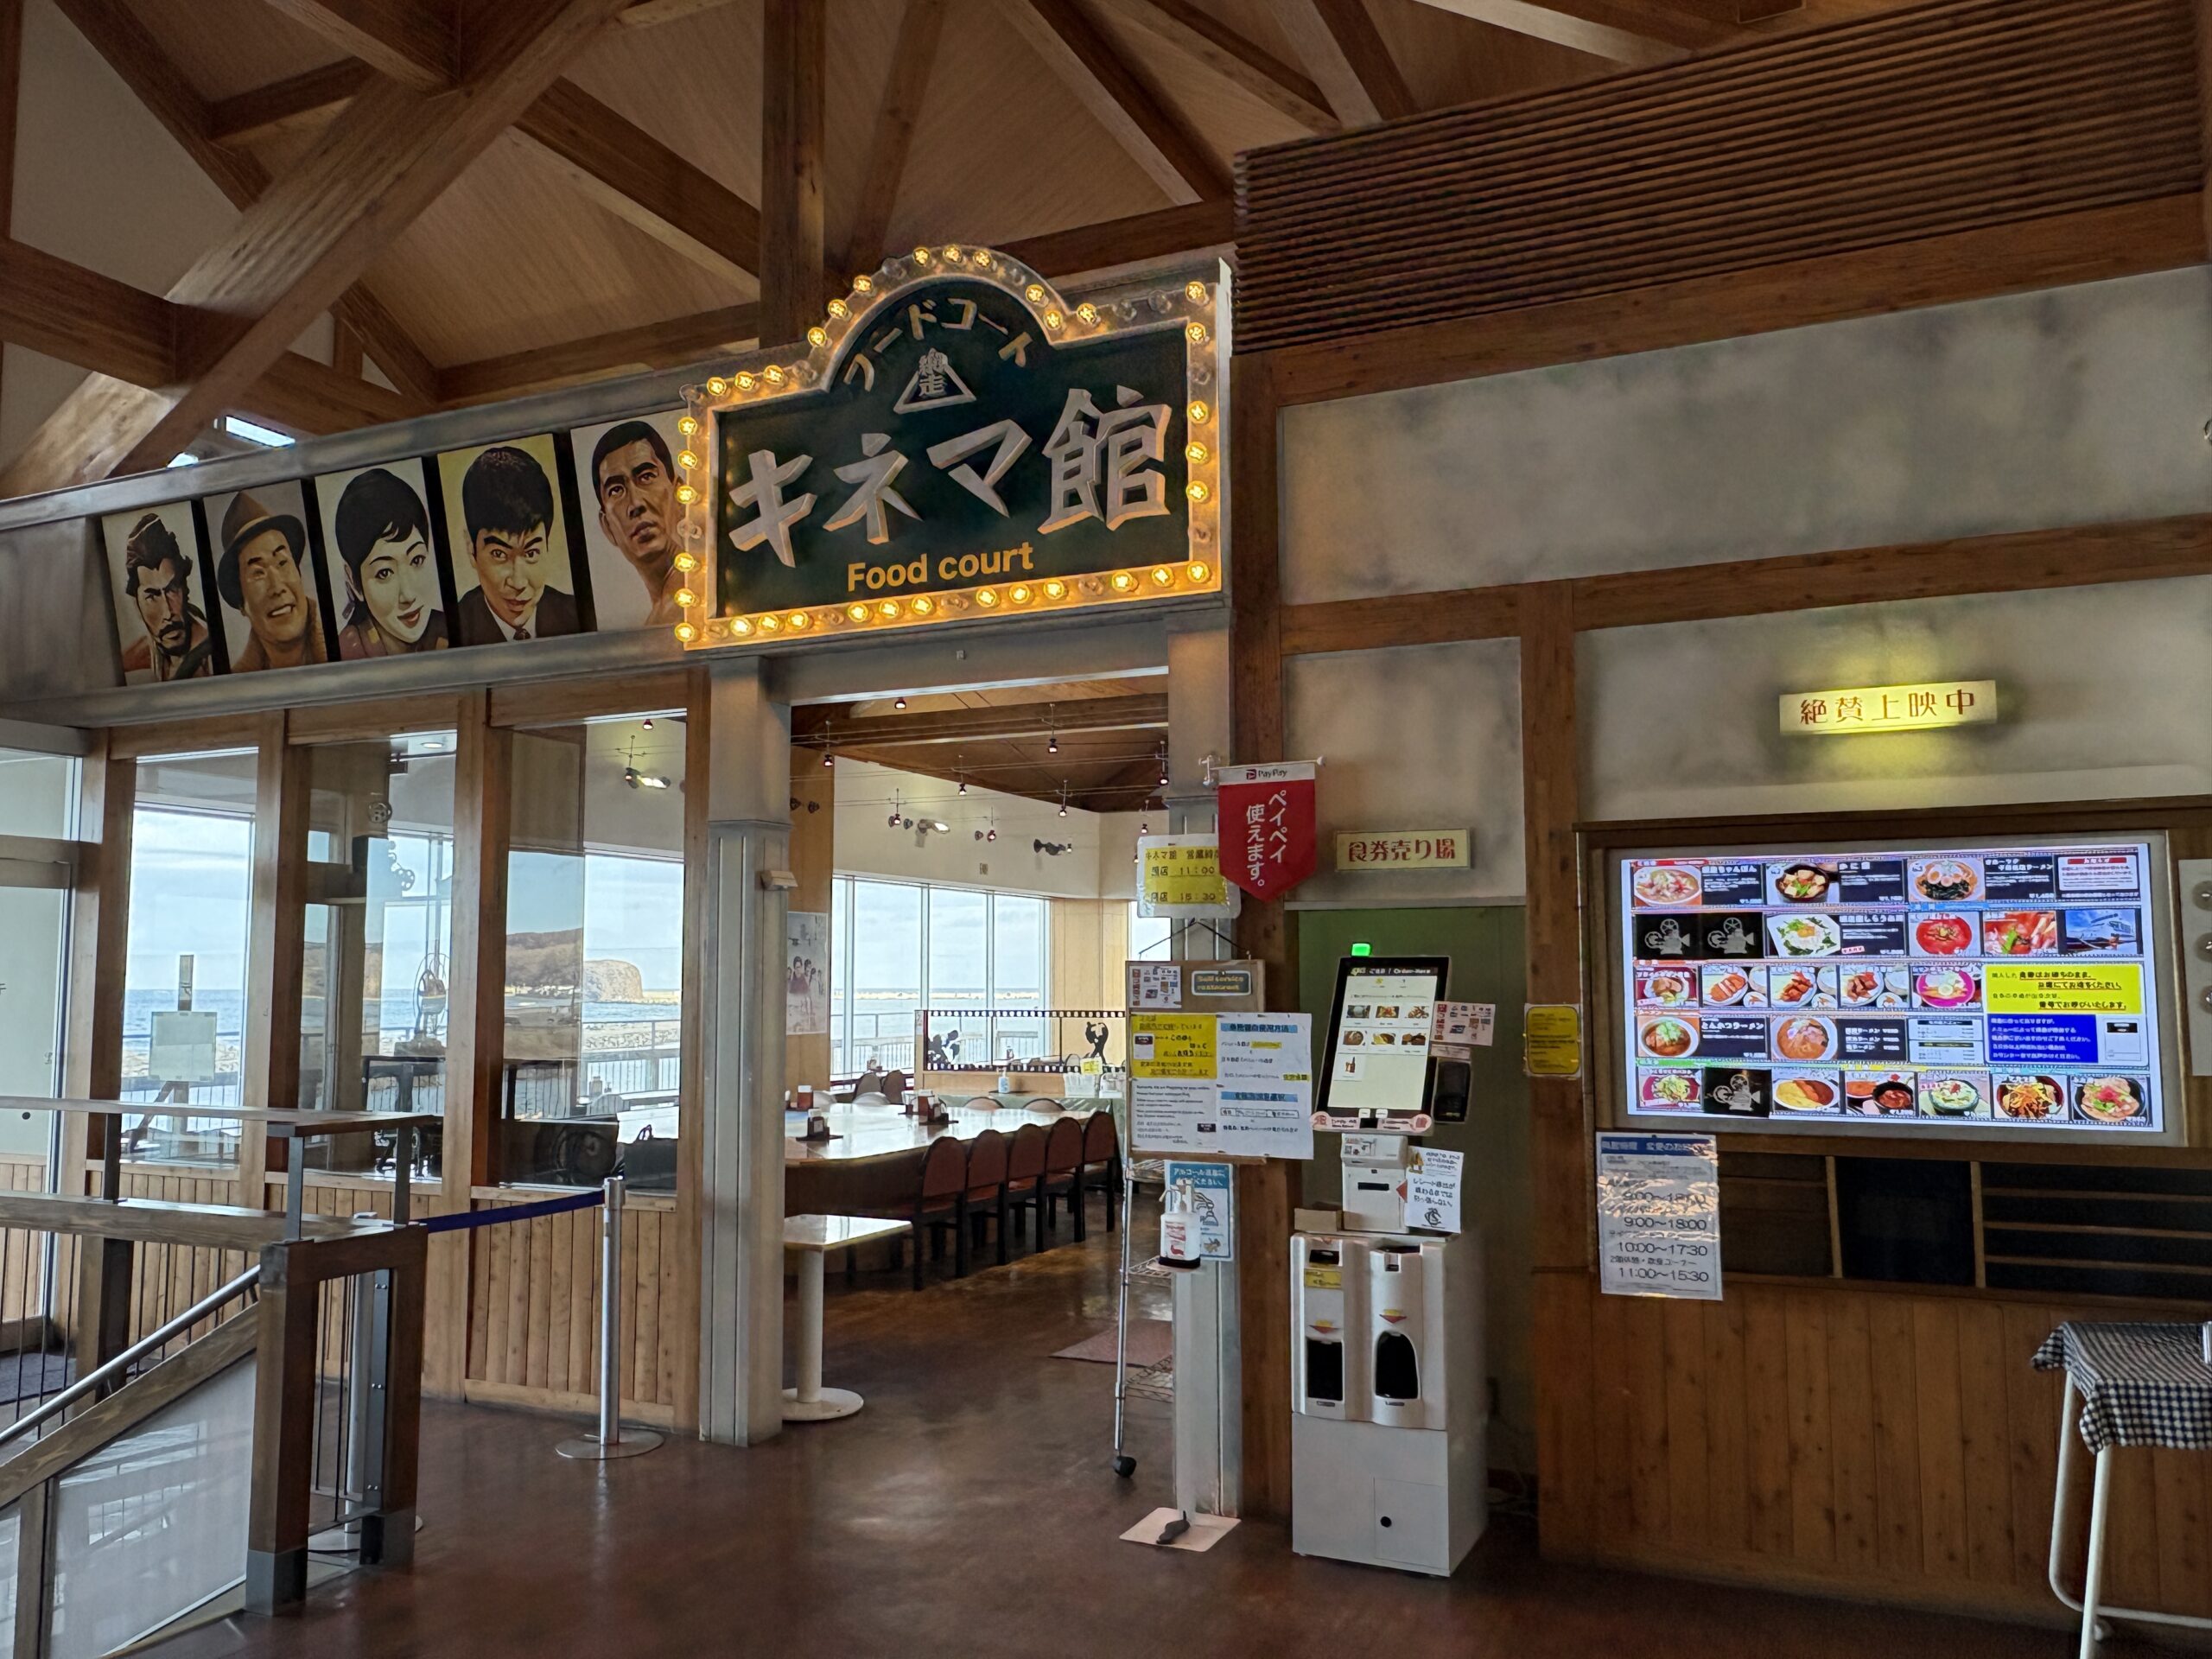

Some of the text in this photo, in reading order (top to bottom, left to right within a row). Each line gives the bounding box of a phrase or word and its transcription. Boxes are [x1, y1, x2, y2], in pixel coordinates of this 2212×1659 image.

[844, 296, 1033, 391] フードコート
[728, 385, 1173, 569] キネマ館
[847, 541, 1034, 592] Food court
[1800, 689, 1975, 725] 絶賛上映中
[1257, 768, 1287, 779] PayPay
[1246, 804, 1266, 887] 使えます。
[1268, 790, 1287, 863] ペイペイ
[1348, 837, 1456, 862] 食券売り場
